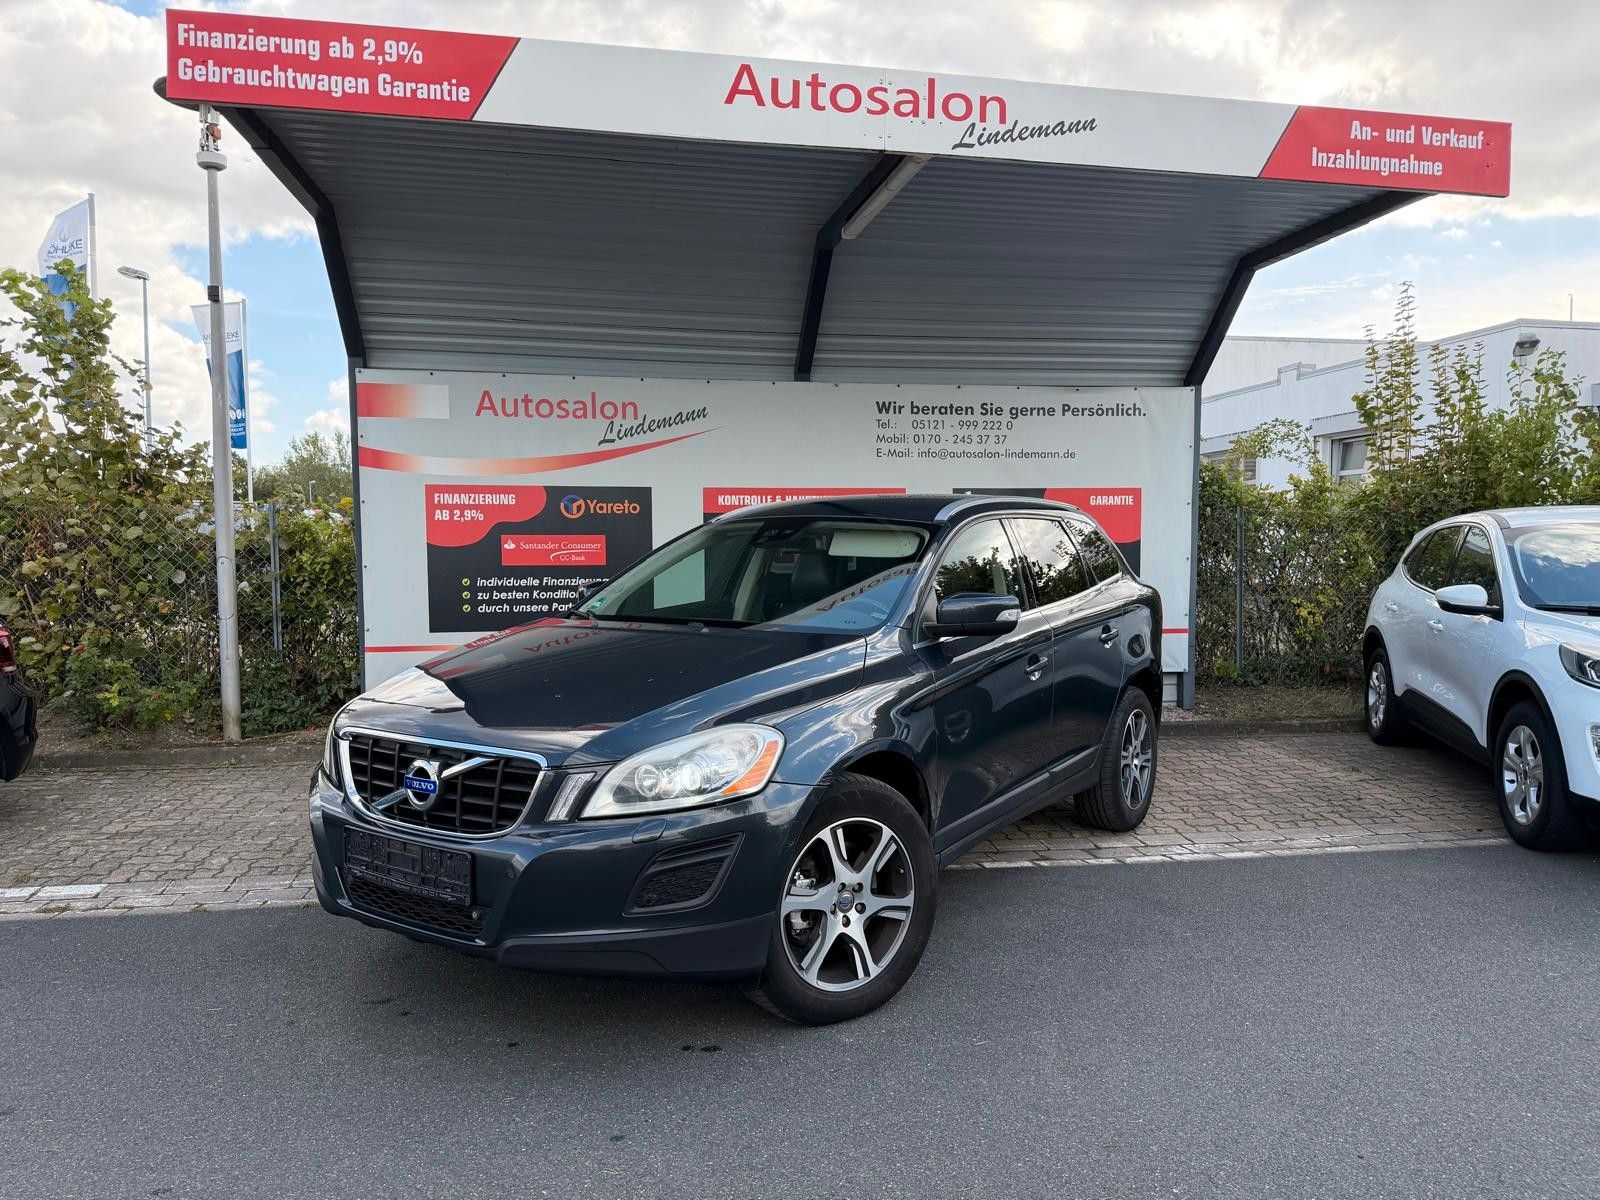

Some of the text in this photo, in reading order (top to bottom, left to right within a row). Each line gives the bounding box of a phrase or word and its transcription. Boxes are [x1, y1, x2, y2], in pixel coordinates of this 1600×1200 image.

[177, 23, 423, 66] Finanzierung ab 2,9%
[178, 57, 471, 103] Gebrauchtwagen Garantie
[724, 63, 1007, 125] Autosalon
[951, 117, 1098, 150] Lindemann
[1350, 120, 1484, 149] An- und Verkauf
[1311, 147, 1443, 176] Inzahlungnahme
[475, 390, 639, 420] Autosalon
[876, 401, 1147, 420] Wir beraten Sie gerne Persönlich.
[598, 406, 708, 446] Lindemann
[876, 419, 897, 429] Tel.:
[911, 419, 945, 430] 05121
[958, 420, 979, 430] 999
[982, 420, 1002, 431] 222
[1006, 420, 1013, 431] 0
[876, 433, 909, 444] Mobil:
[913, 434, 941, 444] 0170
[952, 434, 973, 444] 245
[976, 434, 990, 445] 37
[993, 434, 1007, 445] 37
[876, 447, 1076, 460] E-Mail: info@autosalon-lindemann.de
[434, 493, 516, 505] FINANZIERUNG
[718, 494, 773, 506] KONTROLLE
[1089, 495, 1134, 506] GARANTIE
[586, 499, 641, 515] Yareto
[434, 509, 484, 523] AB 2,9%
[519, 541, 602, 550] Santander Consumer
[559, 554, 586, 562] CC-Bank
[476, 576, 540, 587] individuelle
[477, 591, 490, 600] zu
[492, 590, 530, 600] besten
[477, 602, 575, 613] durch unsere Part
[405, 778, 435, 791] VOLVO
